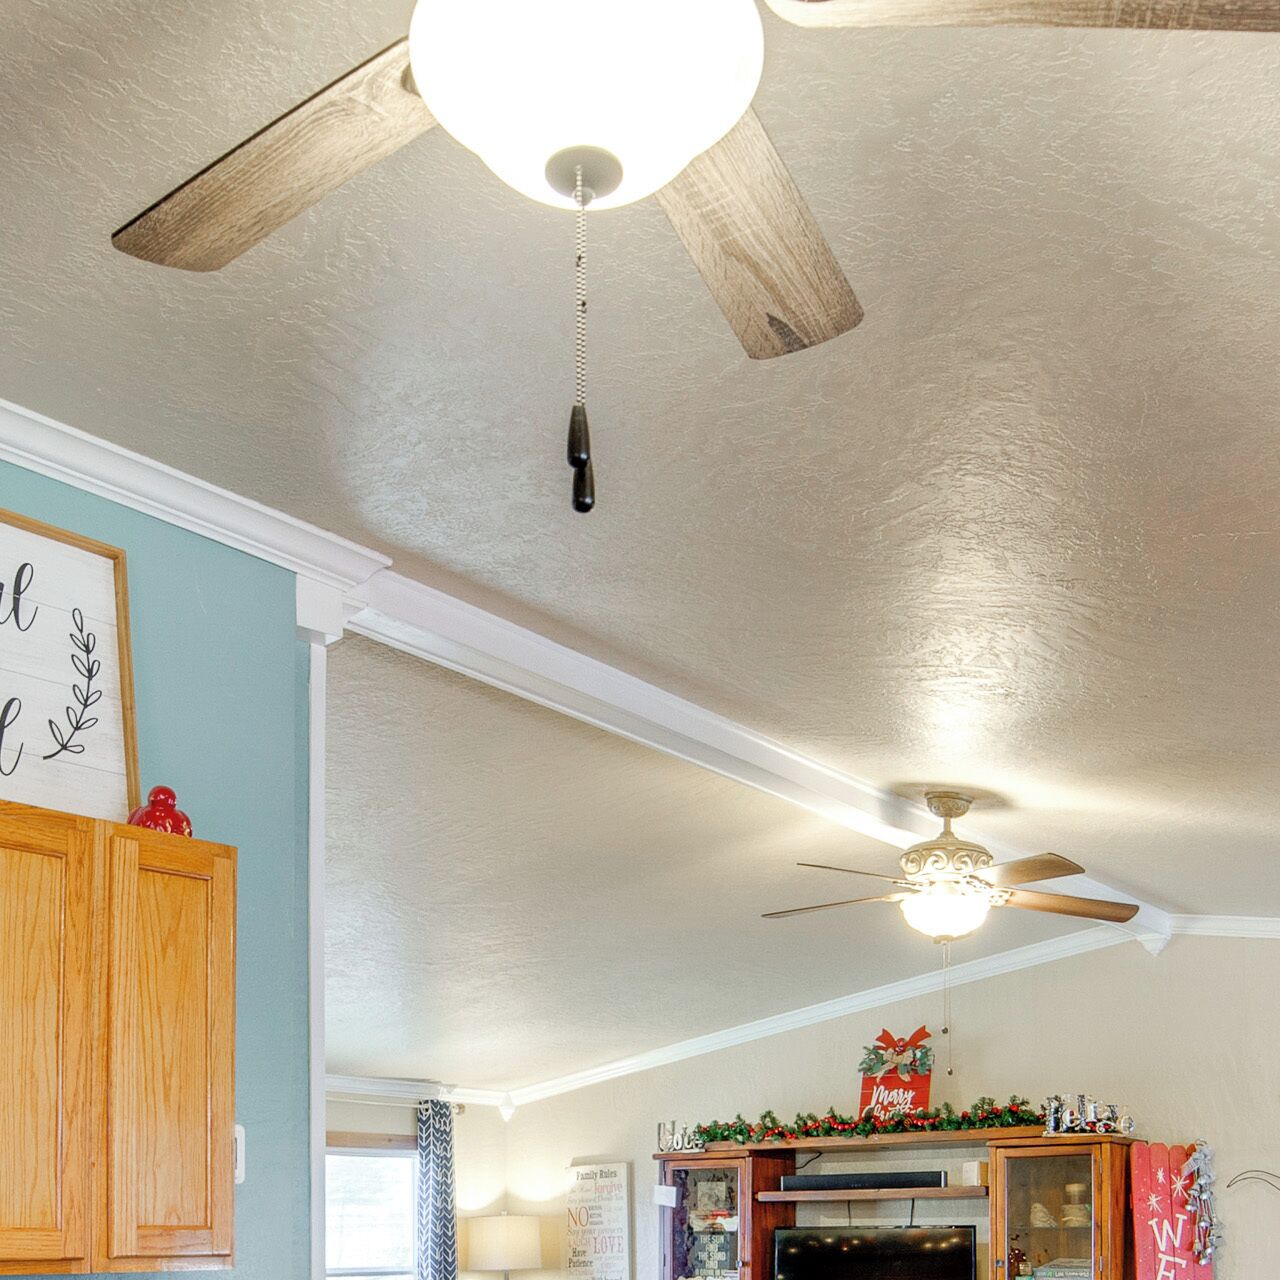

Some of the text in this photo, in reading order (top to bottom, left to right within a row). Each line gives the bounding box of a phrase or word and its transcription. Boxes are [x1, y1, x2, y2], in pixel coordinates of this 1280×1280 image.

[871, 1085, 916, 1112] Merry
[576, 1169, 618, 1181] Family Rules
[567, 1206, 589, 1228] NO
[572, 1247, 587, 1257] Have
[593, 1236, 624, 1254] LOVE
[568, 1258, 594, 1268] Patience
